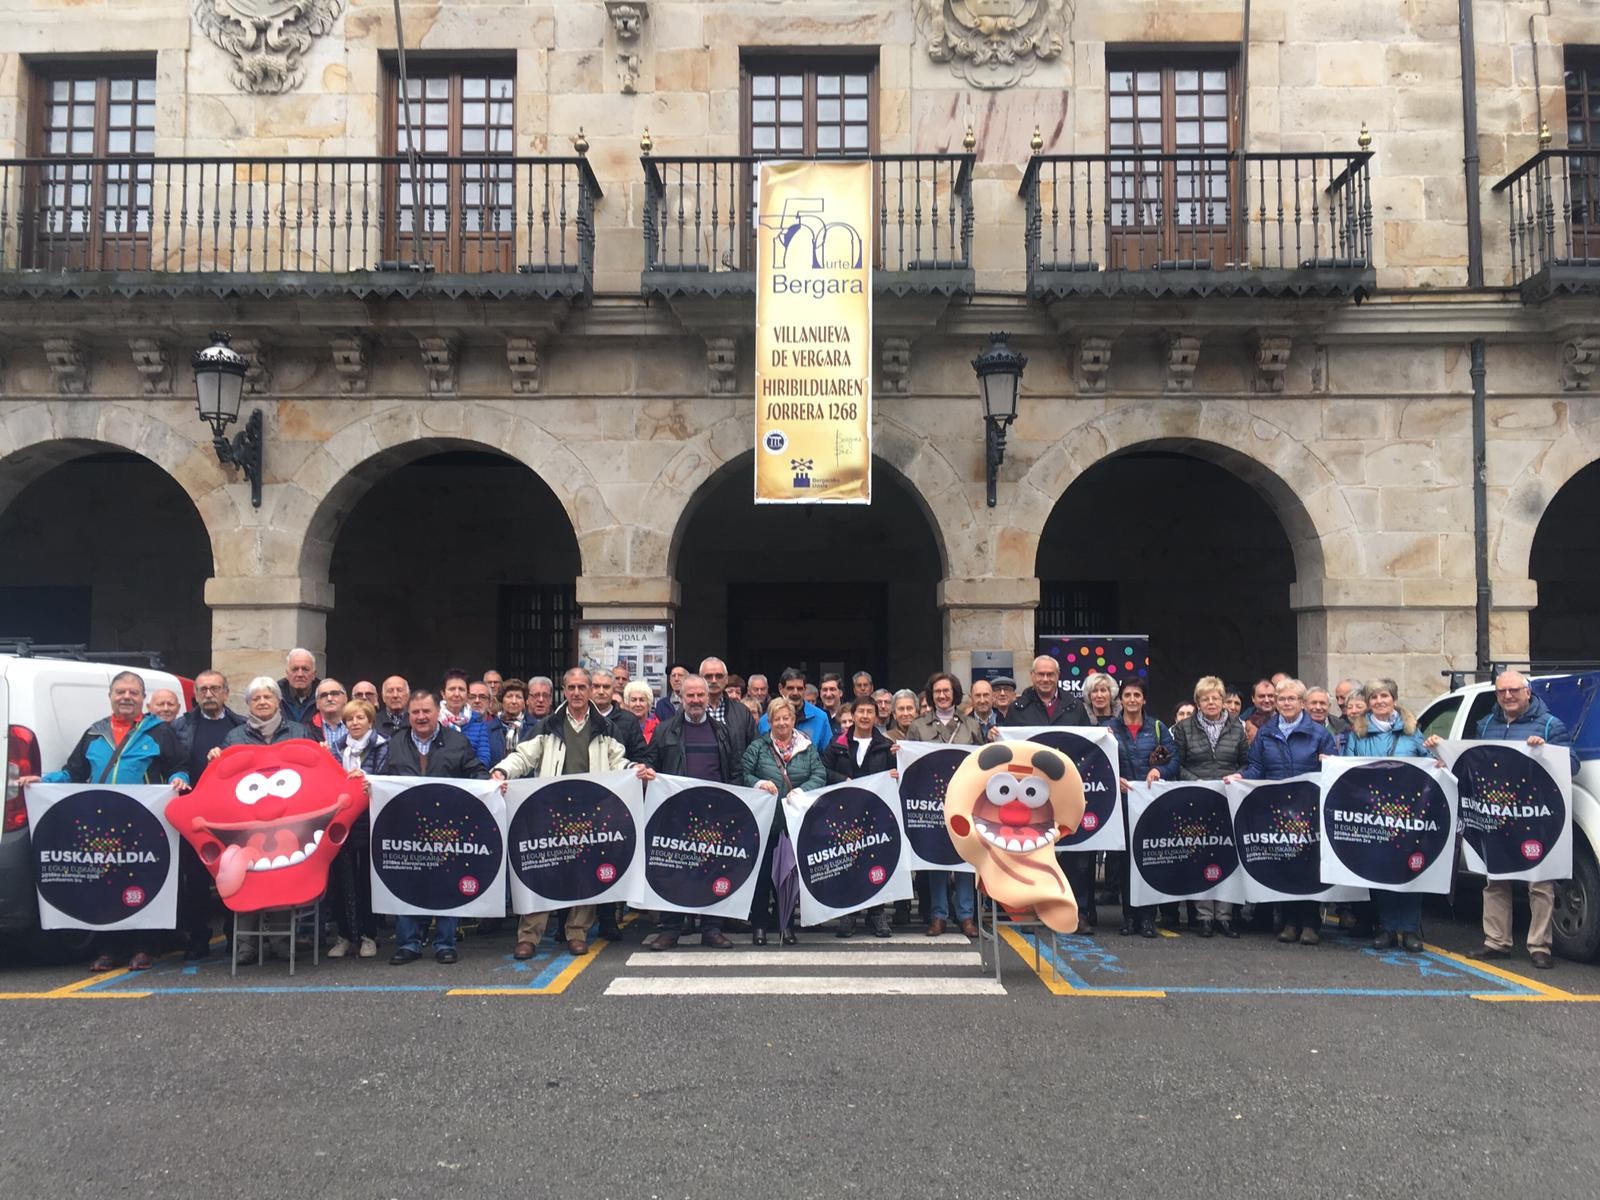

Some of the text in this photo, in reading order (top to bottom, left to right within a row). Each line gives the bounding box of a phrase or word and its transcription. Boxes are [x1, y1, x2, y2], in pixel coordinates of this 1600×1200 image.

[826, 259, 850, 269] urte
[773, 274, 863, 299] Bergara
[773, 325, 851, 344] VILLANUEVA
[771, 349, 852, 368] DE VERGARA
[762, 378, 863, 397] HIRIBILDUAREN
[766, 402, 858, 421] SORRERA 1268
[1082, 781, 1106, 793] DIA
[1333, 810, 1438, 831] EUSKARALDIA
[382, 839, 490, 855] EUSKARALDIA
[519, 831, 624, 852] EUSKARALDIA
[651, 836, 747, 859] EUSKARALDIA
[807, 832, 890, 866] EUSKARALDIA
[1142, 836, 1234, 849] EUSKARALDIA
[40, 851, 157, 864] EUSKARALDIA
